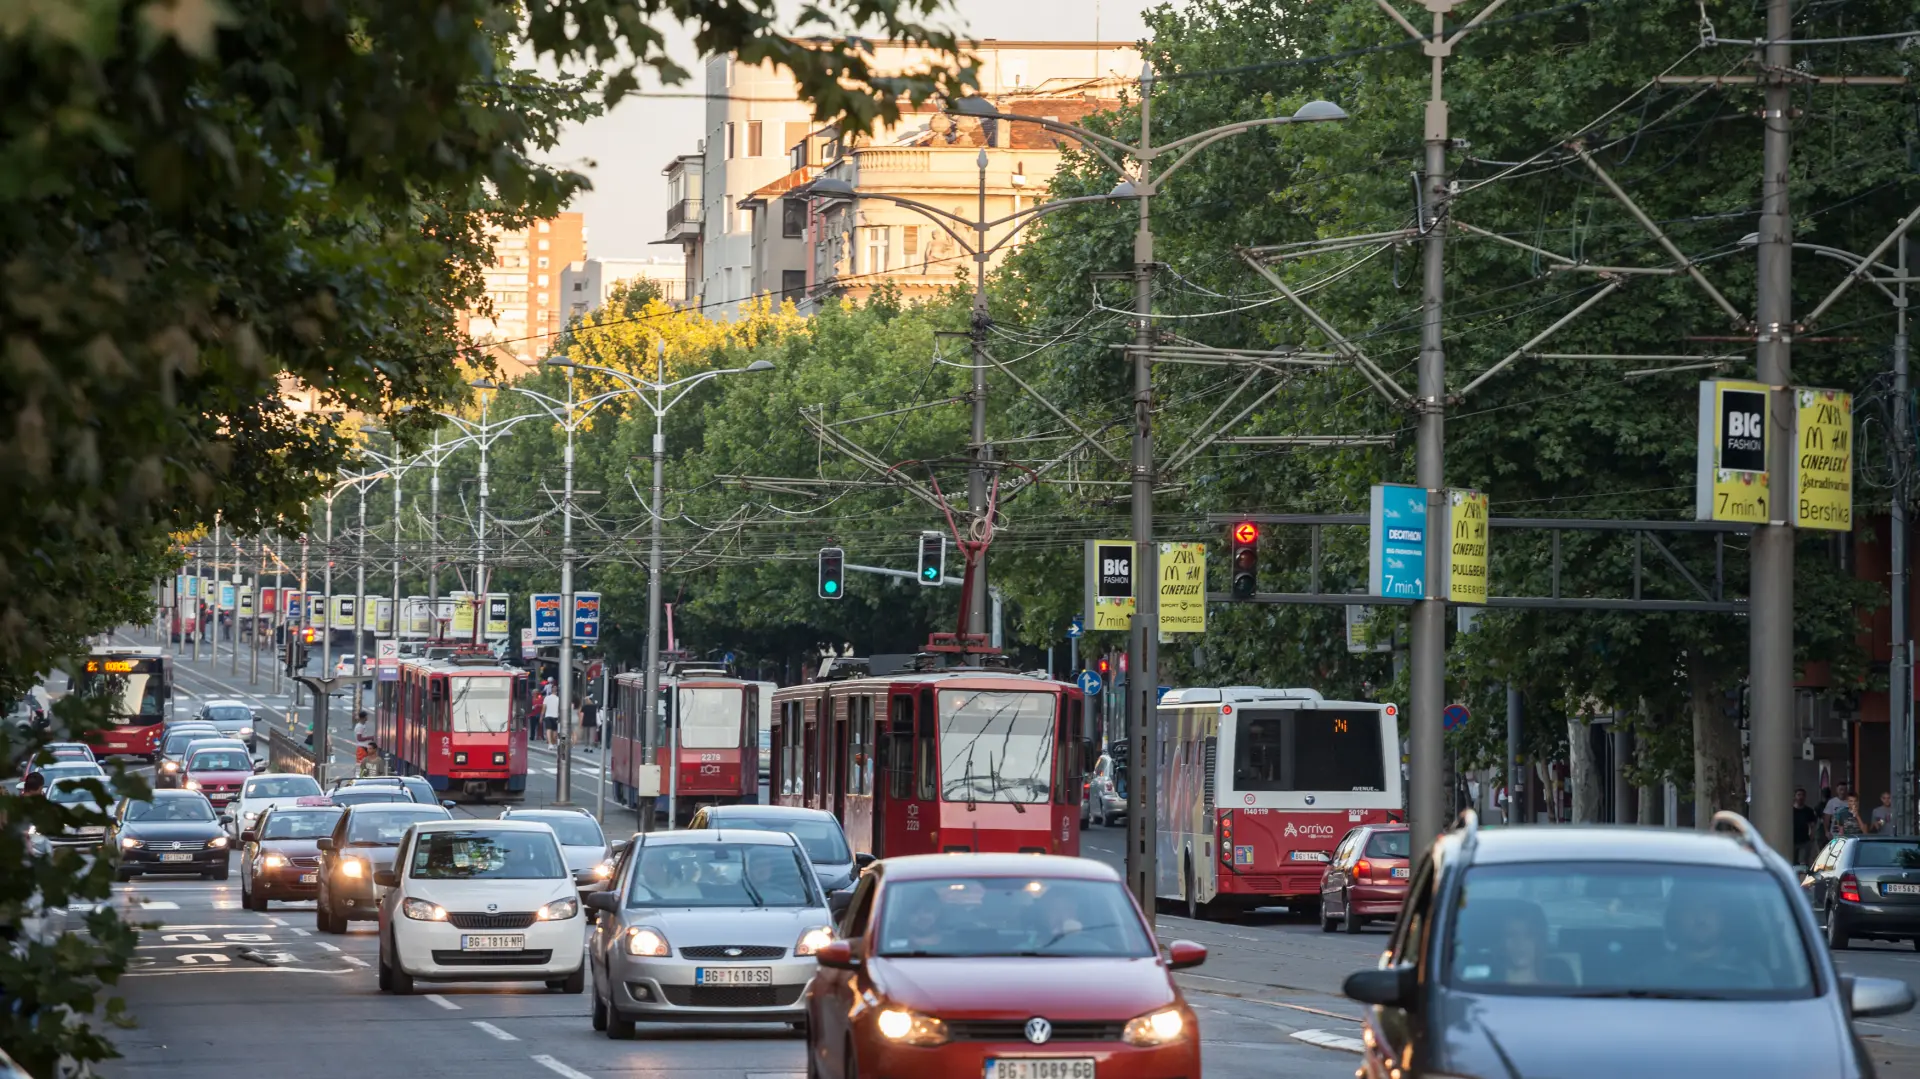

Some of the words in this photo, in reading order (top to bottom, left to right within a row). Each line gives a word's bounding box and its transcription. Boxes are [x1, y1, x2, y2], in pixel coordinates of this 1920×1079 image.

[1816, 403, 1842, 425] ZARA
[1728, 411, 1761, 437] BIG
[1728, 438, 1761, 450] FASHION
[1801, 453, 1849, 472] CINEPLEXX
[1718, 492, 1729, 514] 7
[1731, 498, 1757, 516] min.
[1800, 498, 1849, 523] Bershka
[1174, 550, 1195, 564] ZARA
[1104, 559, 1128, 576] BIG
[1452, 564, 1486, 578] PULL&BEAR
[1104, 576, 1128, 584] FASHION
[1384, 574, 1394, 592] 7
[1395, 580, 1415, 594] min.
[1160, 582, 1202, 595] CINEPLEXX
[1452, 584, 1486, 595] RESERVED
[492, 604, 506, 612] BIG
[1097, 612, 1105, 626] 7
[1106, 616, 1127, 627] min.
[1160, 616, 1203, 624] SPRINGFIELD
[702, 753, 720, 761] 2279
[1299, 824, 1334, 834] arriva
[1888, 884, 1898, 892] BG
[468, 936, 480, 946] BG
[704, 970, 718, 982] BG
[998, 1062, 1017, 1079] BG
